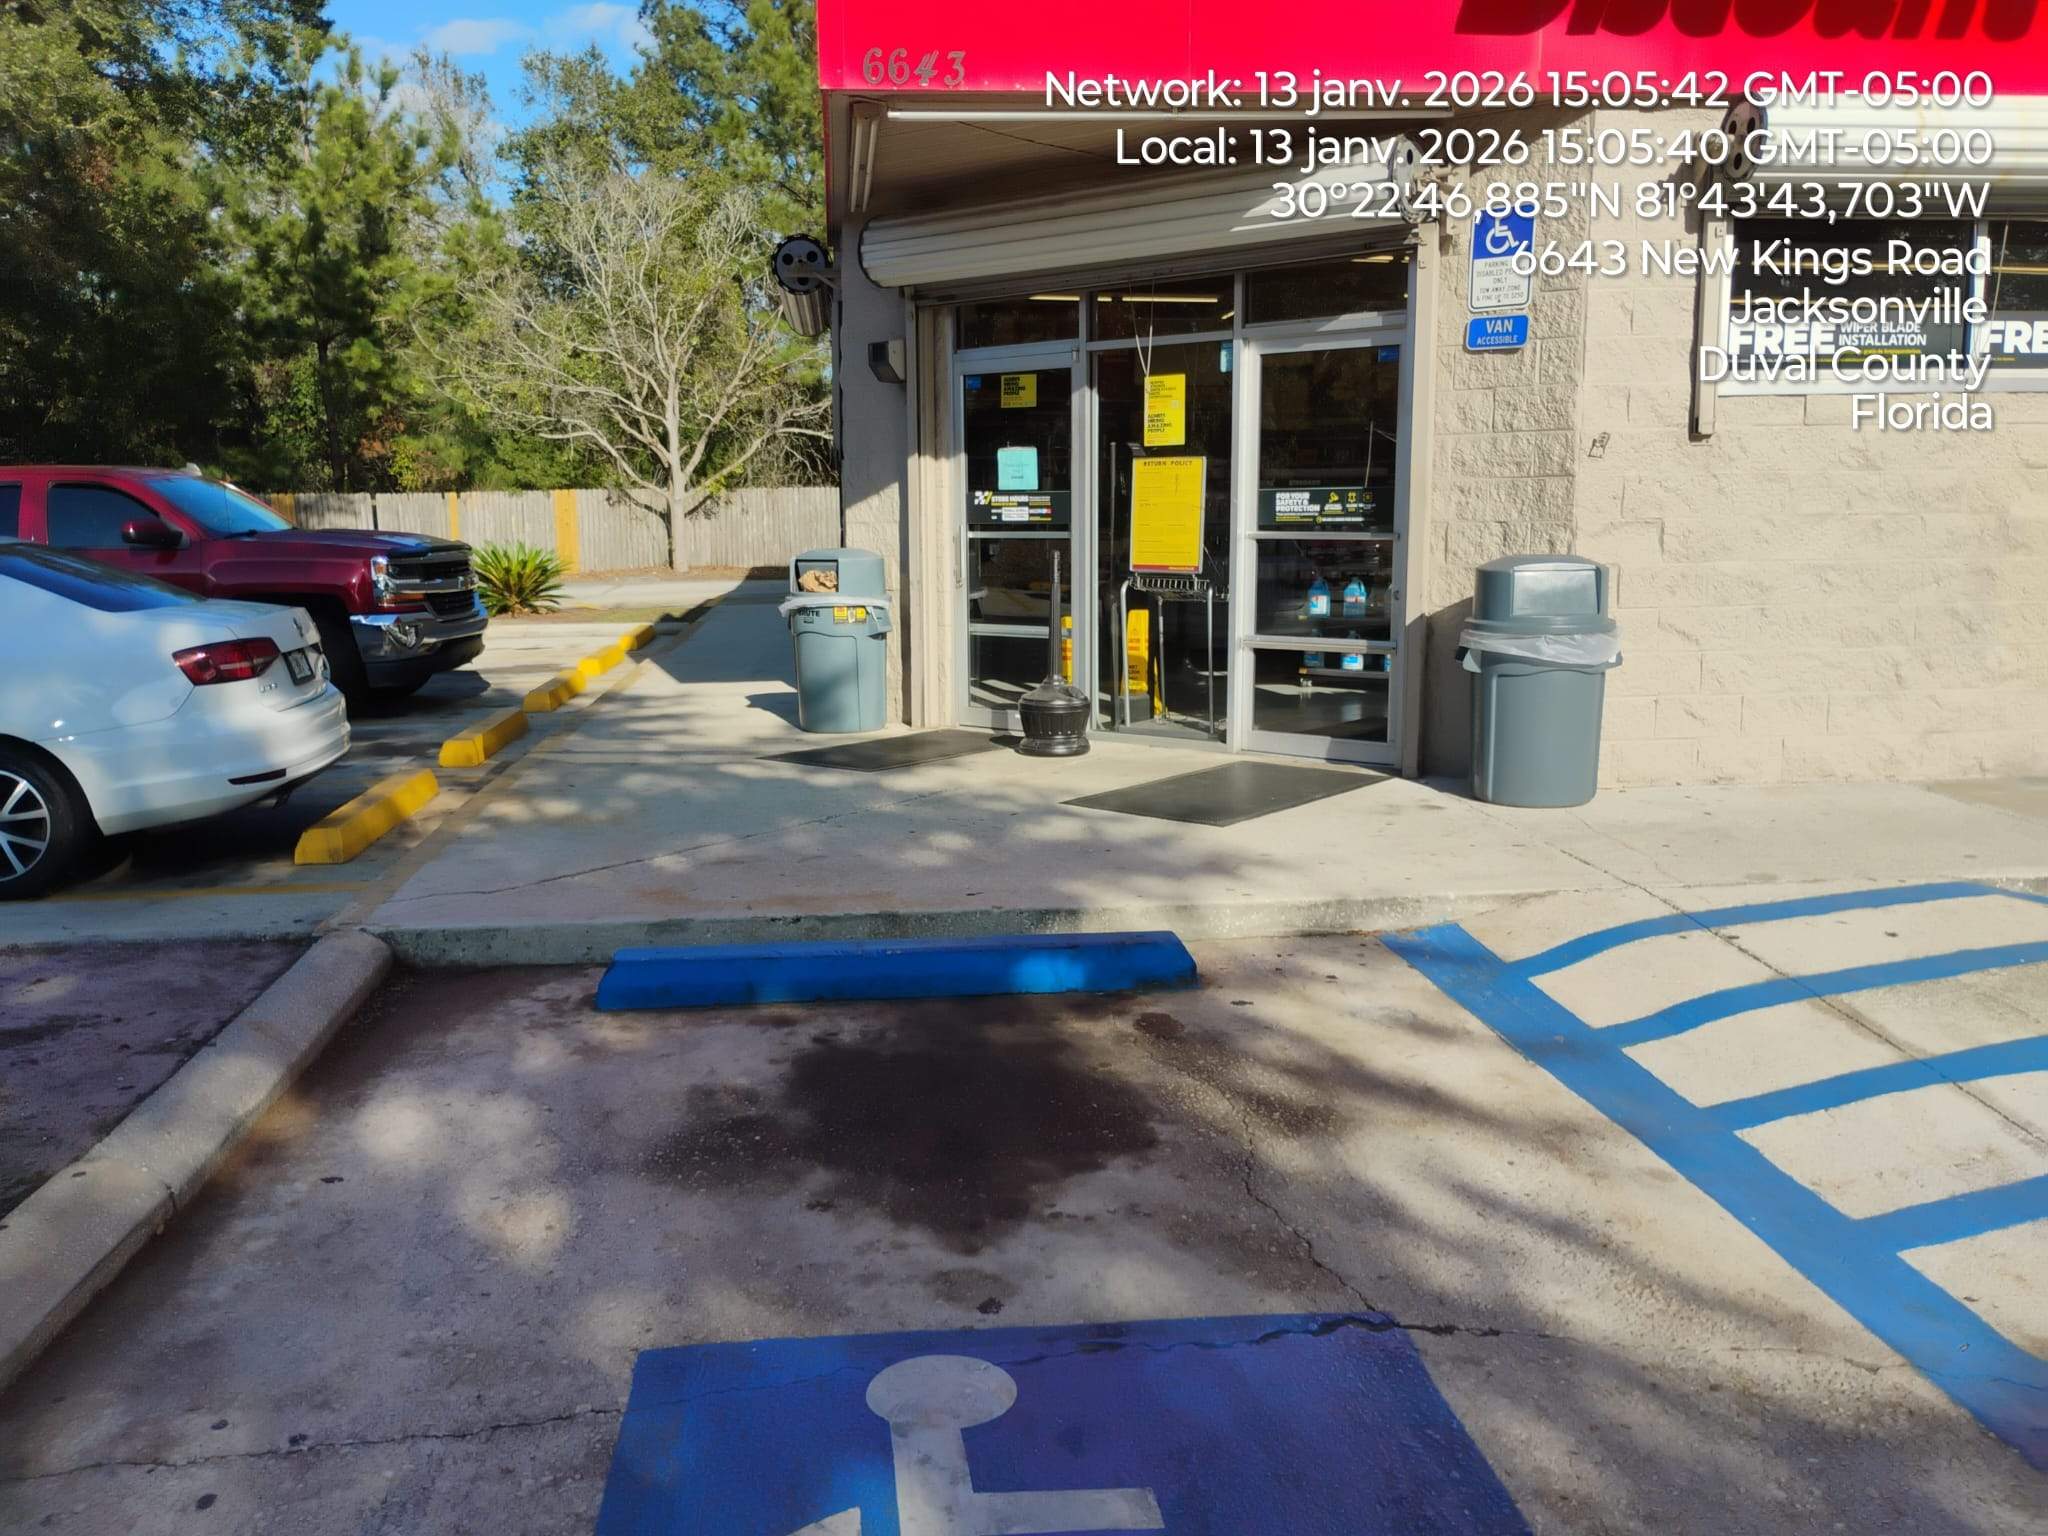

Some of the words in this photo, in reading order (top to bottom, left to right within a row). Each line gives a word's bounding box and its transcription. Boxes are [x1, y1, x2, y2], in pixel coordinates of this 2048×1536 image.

[863, 47, 966, 86] 6643
[1485, 319, 1514, 334] VAN
[1840, 320, 1878, 334] WIPER
[1882, 321, 1921, 334] BLADE
[1476, 335, 1519, 345] ACCESSIBLE
[1727, 322, 1836, 355] FREE
[1838, 333, 1927, 347] INSTALLATION
